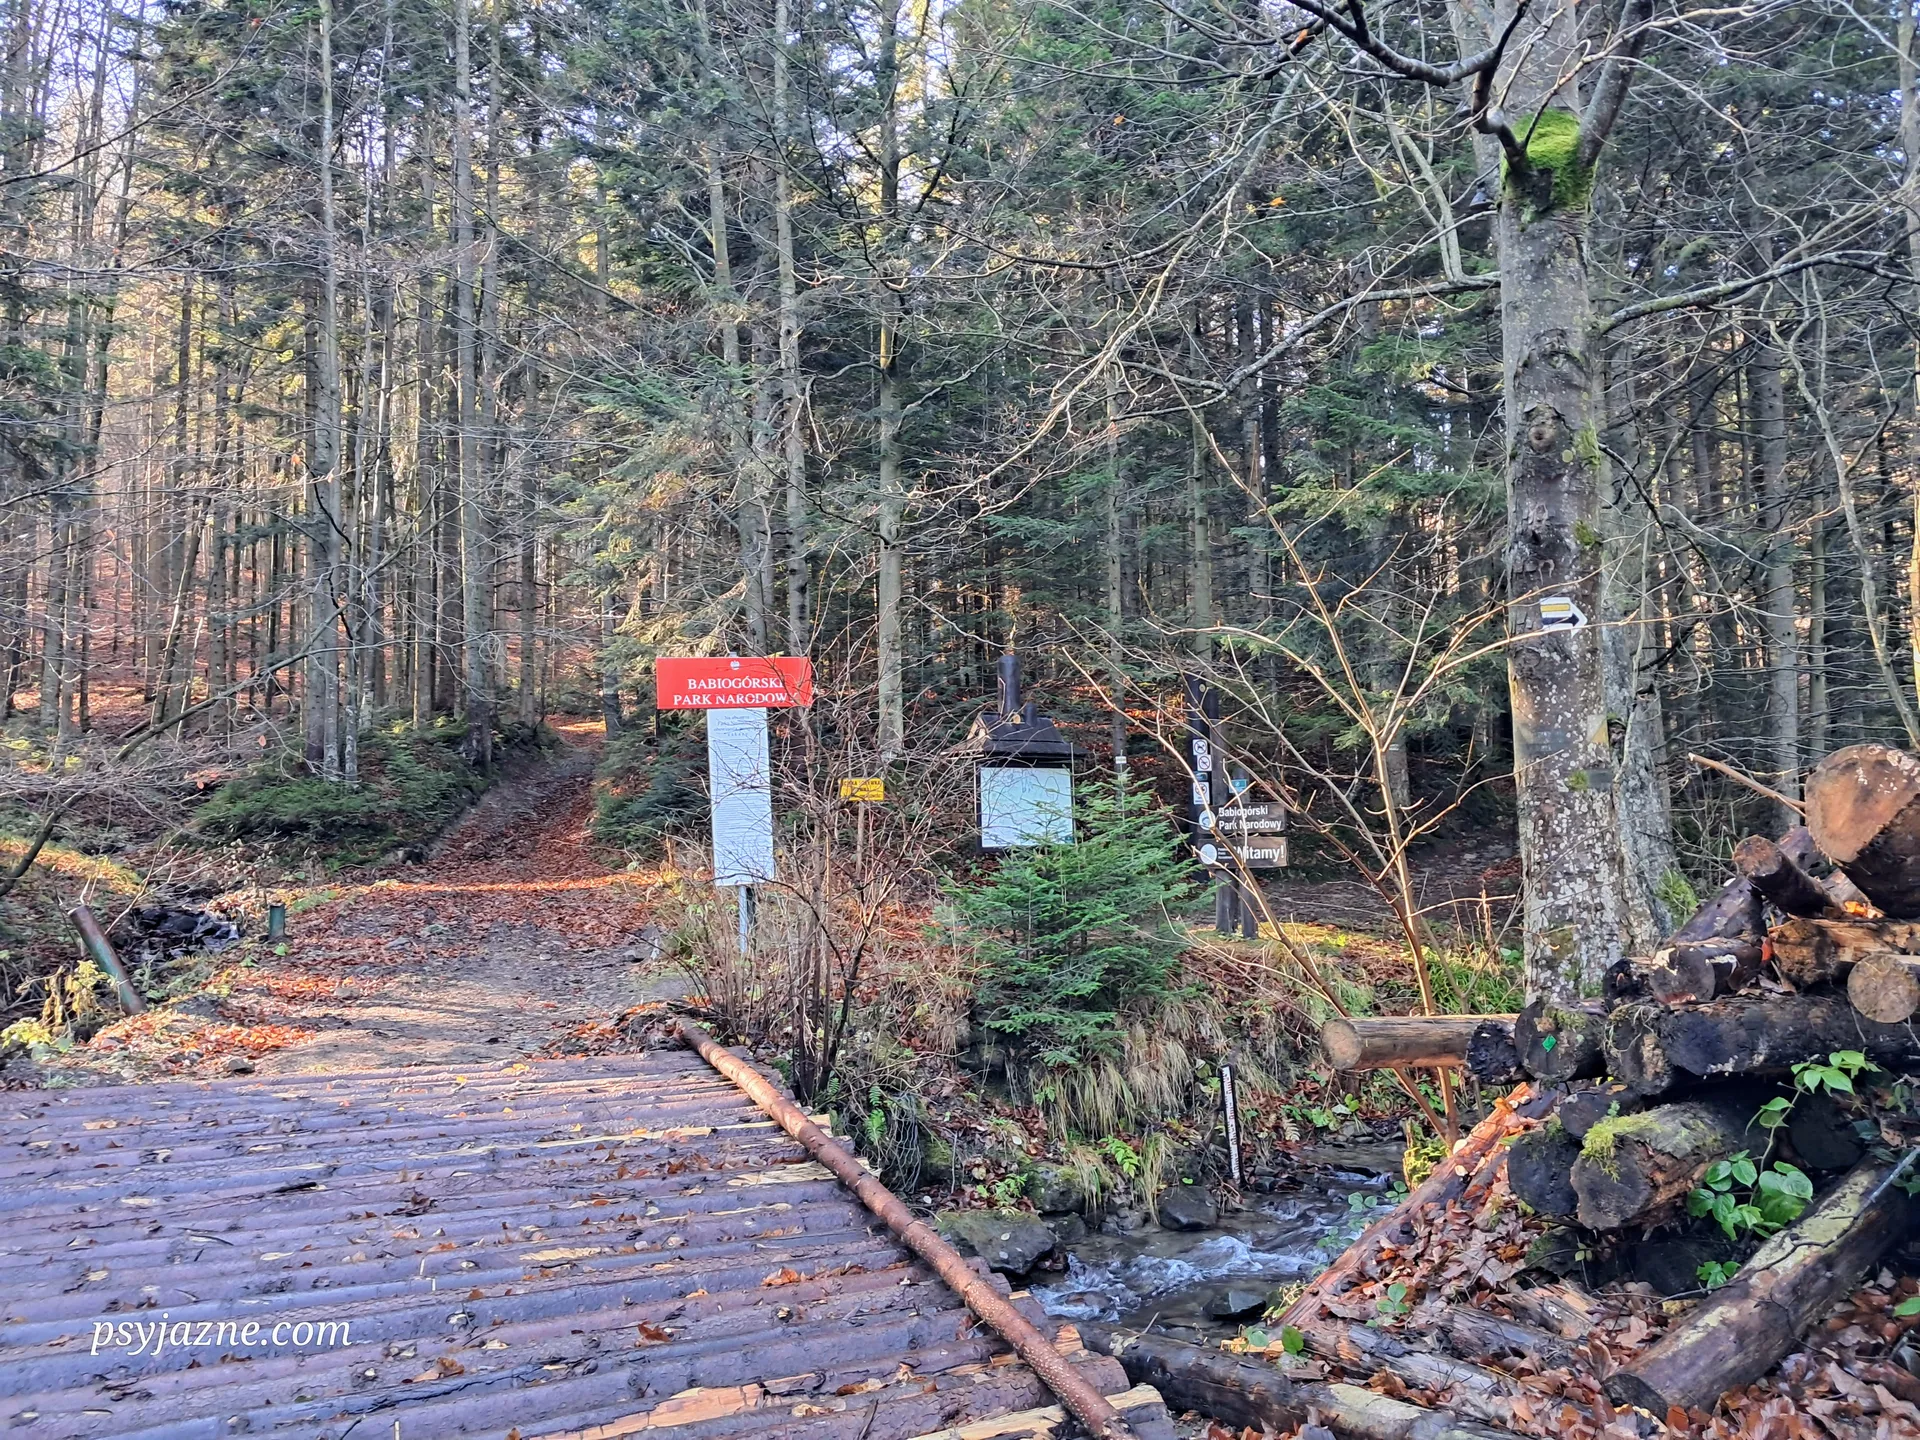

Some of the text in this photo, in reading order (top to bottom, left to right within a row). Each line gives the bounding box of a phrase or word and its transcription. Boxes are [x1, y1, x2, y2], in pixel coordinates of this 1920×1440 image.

[687, 675, 784, 690] BABIOGÓRSKI
[673, 693, 712, 706] PARK
[1218, 804, 1268, 819] Babiogórski
[1218, 818, 1282, 831] Park Narodowy
